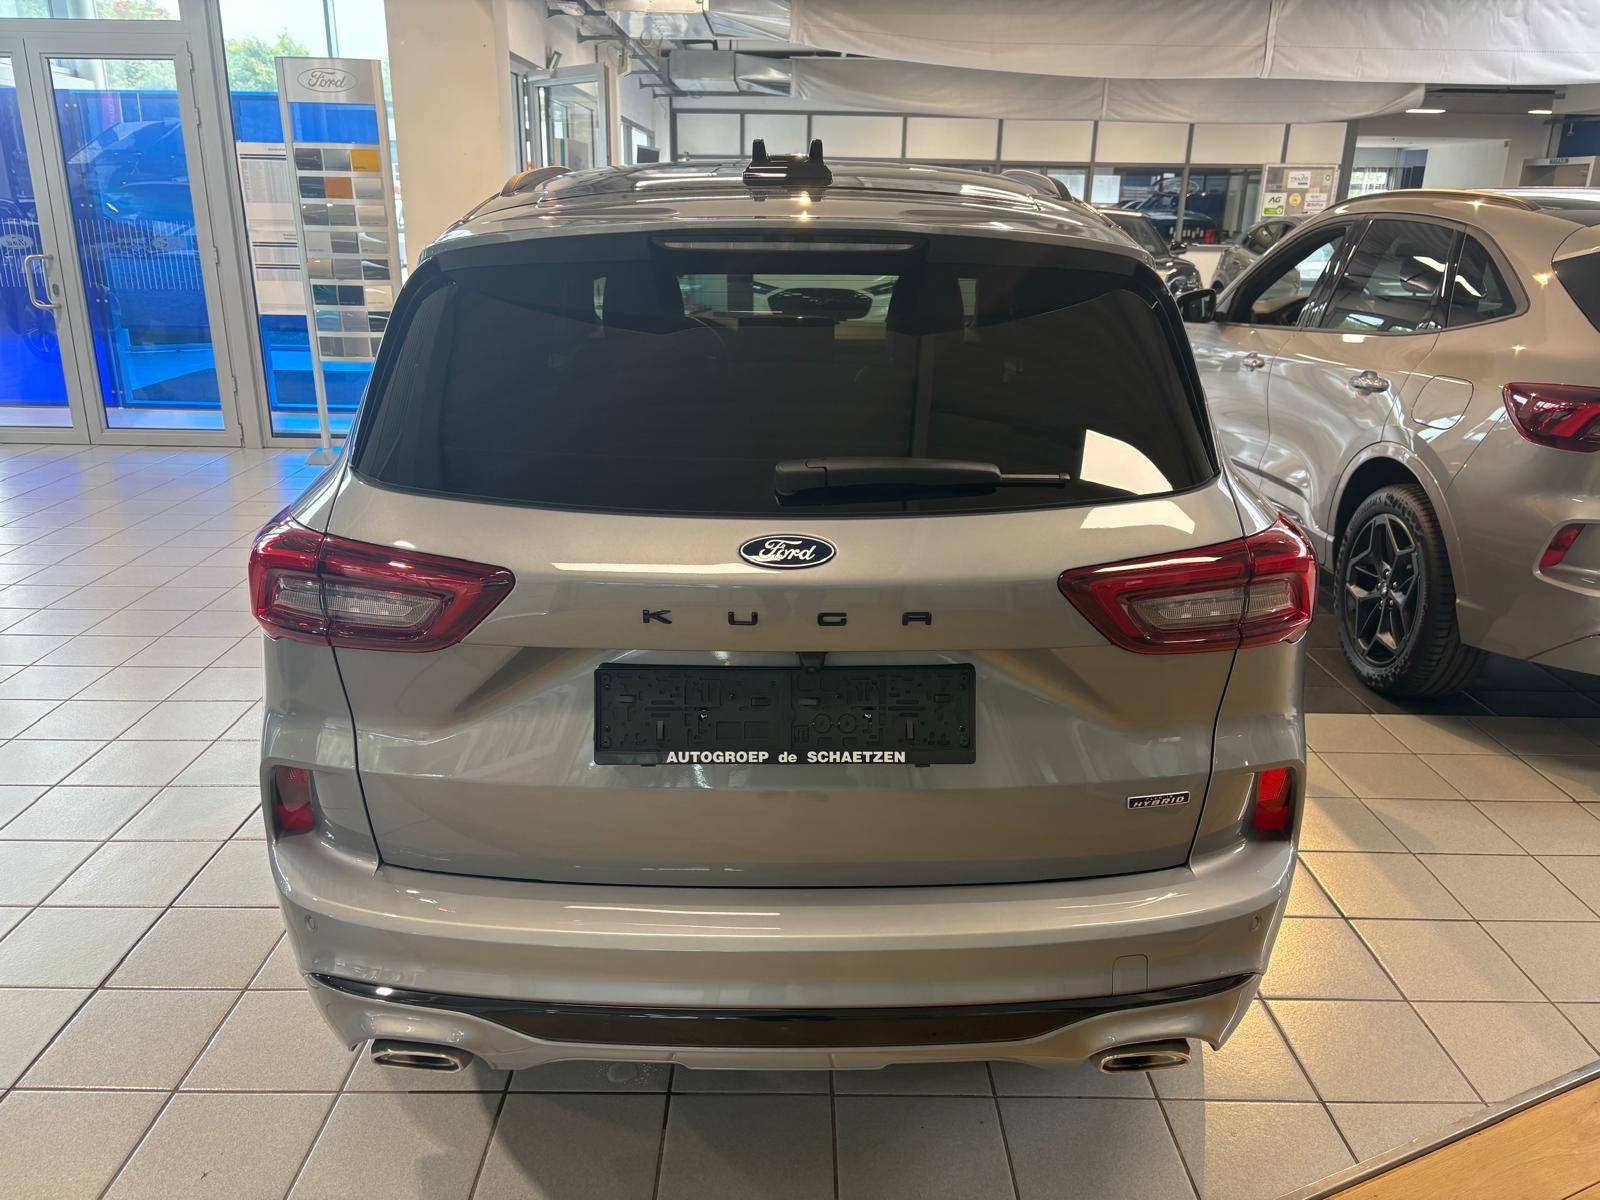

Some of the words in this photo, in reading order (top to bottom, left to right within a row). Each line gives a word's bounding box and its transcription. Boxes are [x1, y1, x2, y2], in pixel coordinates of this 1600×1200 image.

[308, 70, 346, 89] Ford
[758, 539, 817, 561] Ford
[642, 609, 933, 627] KUGA
[666, 751, 769, 763] AUTOGROEP
[778, 751, 798, 763] de
[806, 751, 906, 763] SCHAETZEN
[1133, 796, 1185, 808] HYBRID
